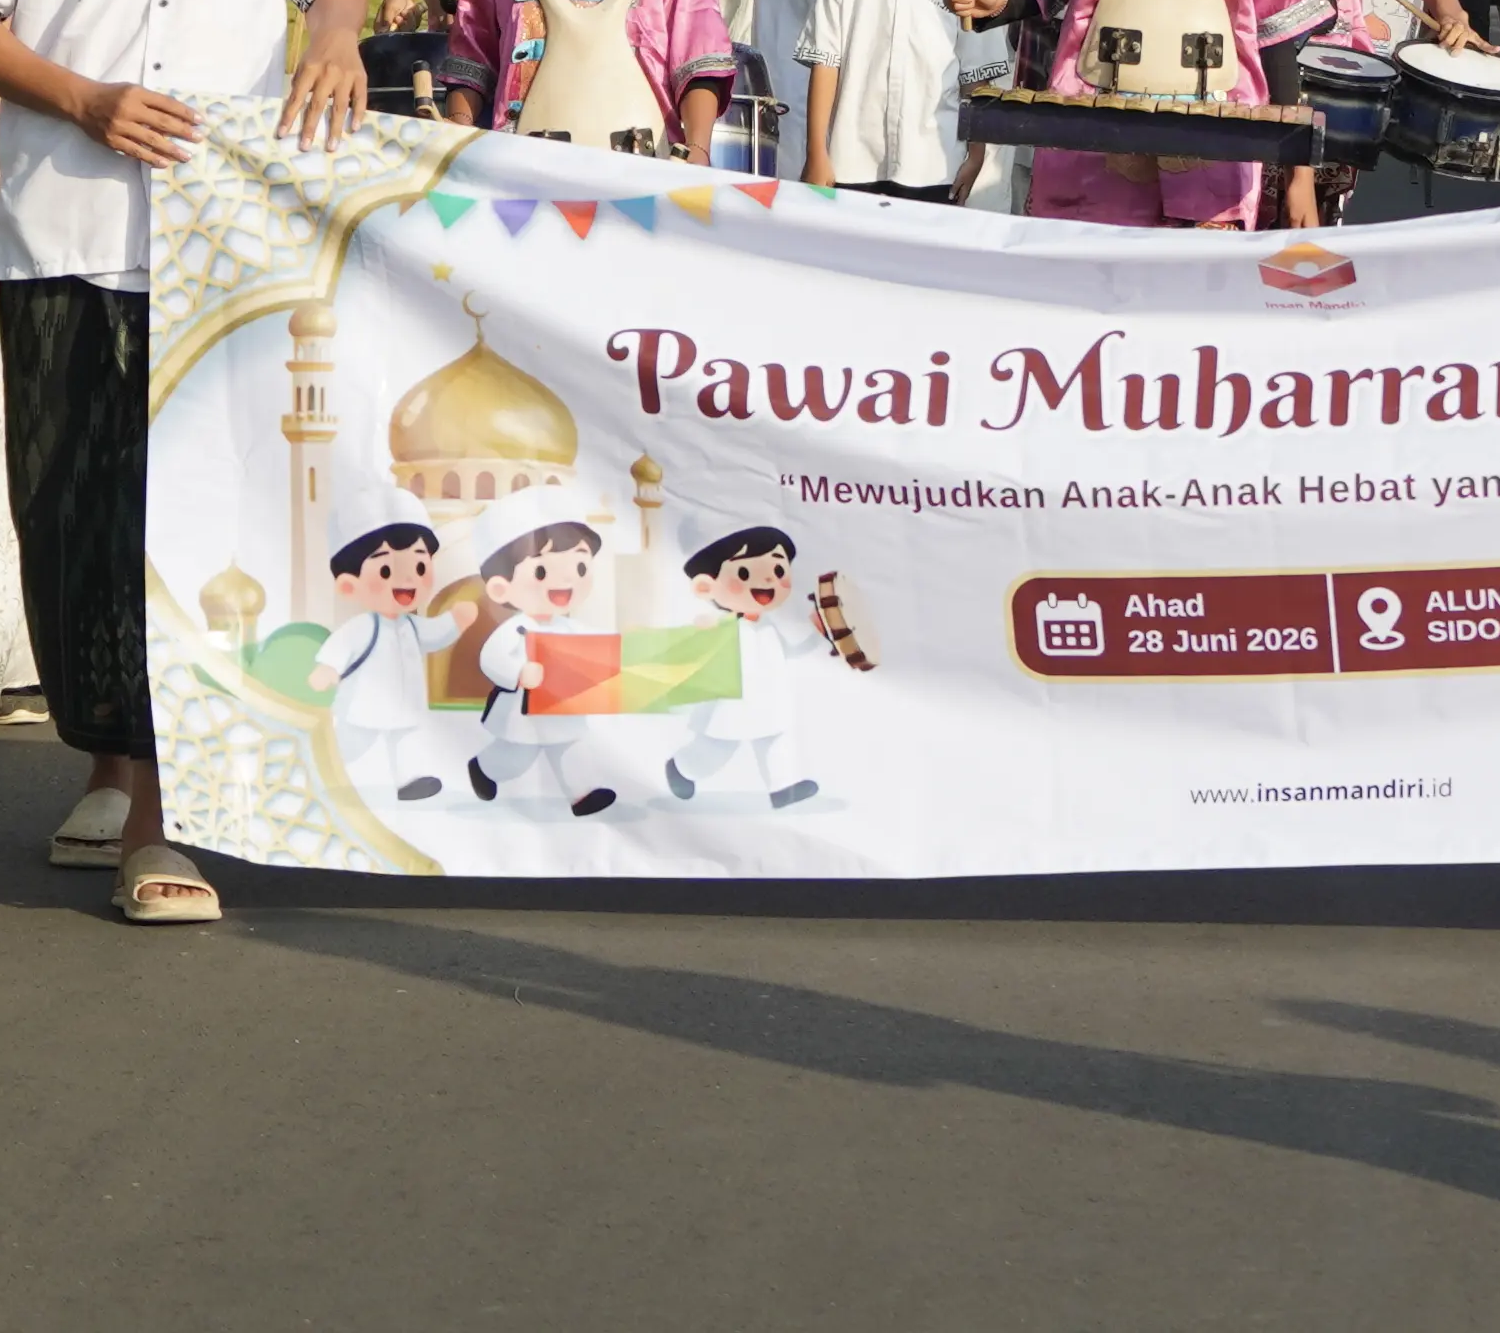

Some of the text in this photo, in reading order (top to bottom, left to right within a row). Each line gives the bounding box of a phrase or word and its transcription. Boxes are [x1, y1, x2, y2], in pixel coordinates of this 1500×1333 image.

[605, 326, 951, 428] Pawai
[1061, 475, 1283, 509] Anak-Anak
[1299, 472, 1417, 504] Hebat
[1124, 592, 1205, 618] Ahad
[1128, 626, 1319, 653] 28 Juni 2026
[1190, 777, 1453, 804] www.insanmandiri.id
